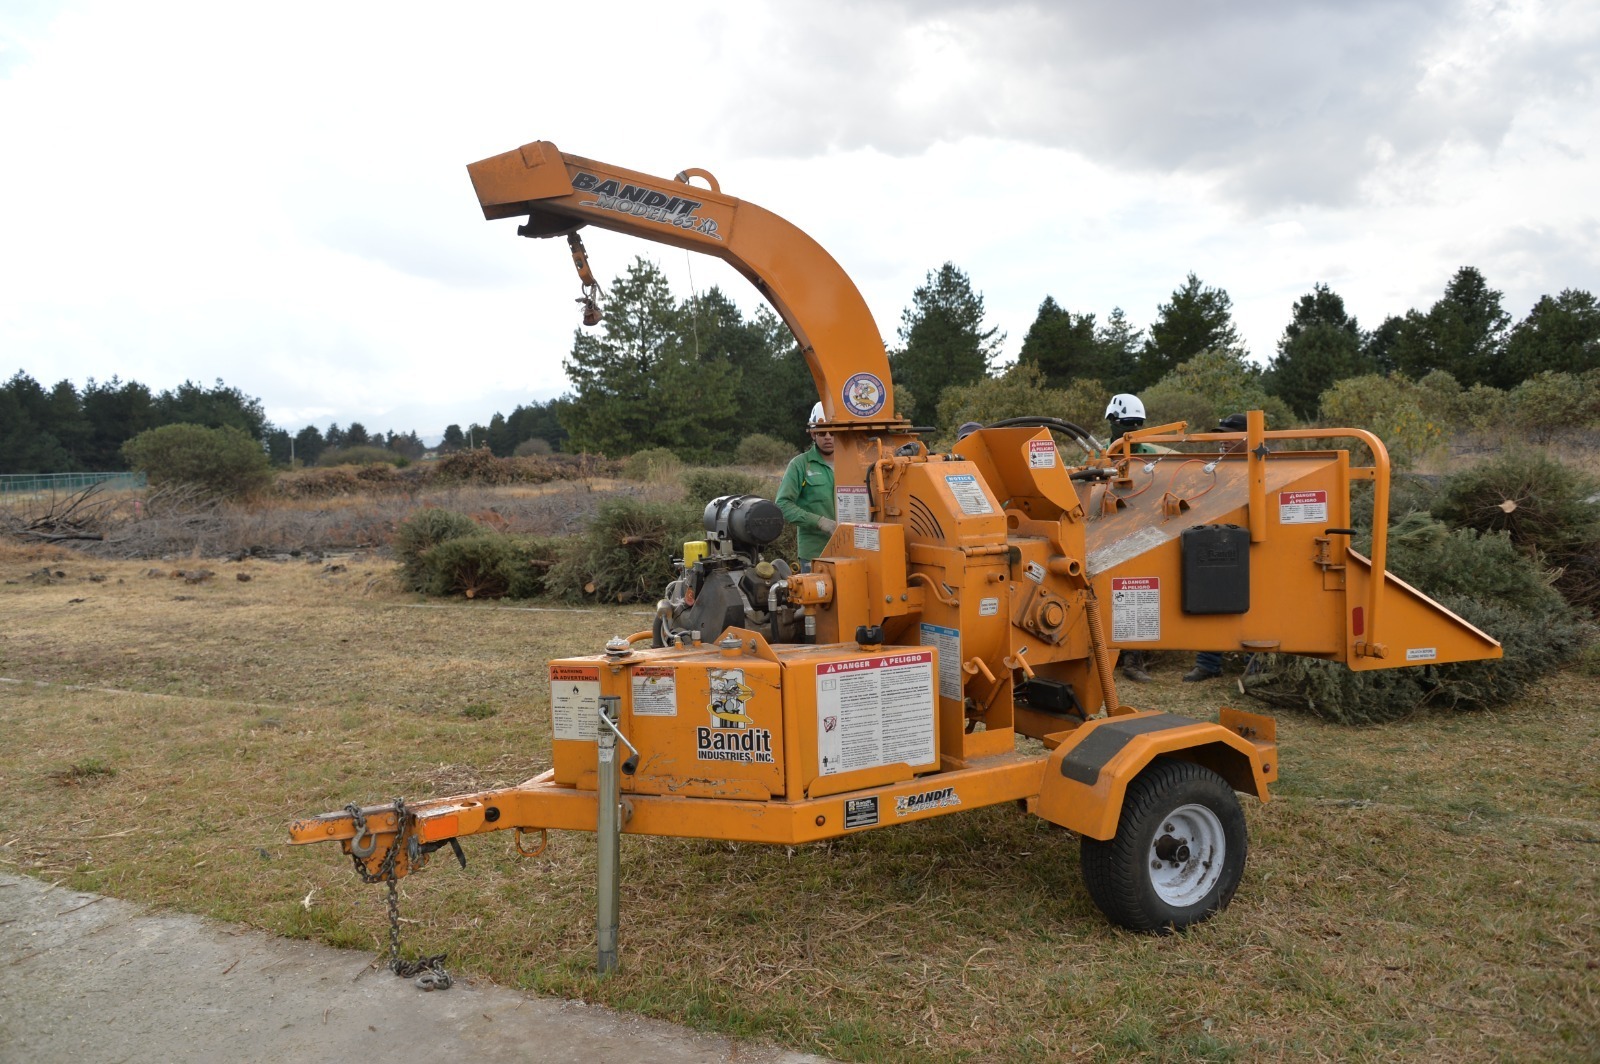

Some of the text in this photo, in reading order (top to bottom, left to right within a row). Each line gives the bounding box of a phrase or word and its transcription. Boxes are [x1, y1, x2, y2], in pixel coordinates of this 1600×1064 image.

[571, 172, 702, 215] BANDIT
[595, 192, 718, 236] MODEL 65 XP
[837, 654, 922, 671] DANGER PELIGRO
[697, 727, 771, 752] Bandit
[698, 750, 774, 762] INDUSTRIES, INC.
[908, 787, 954, 807] BANDIT
